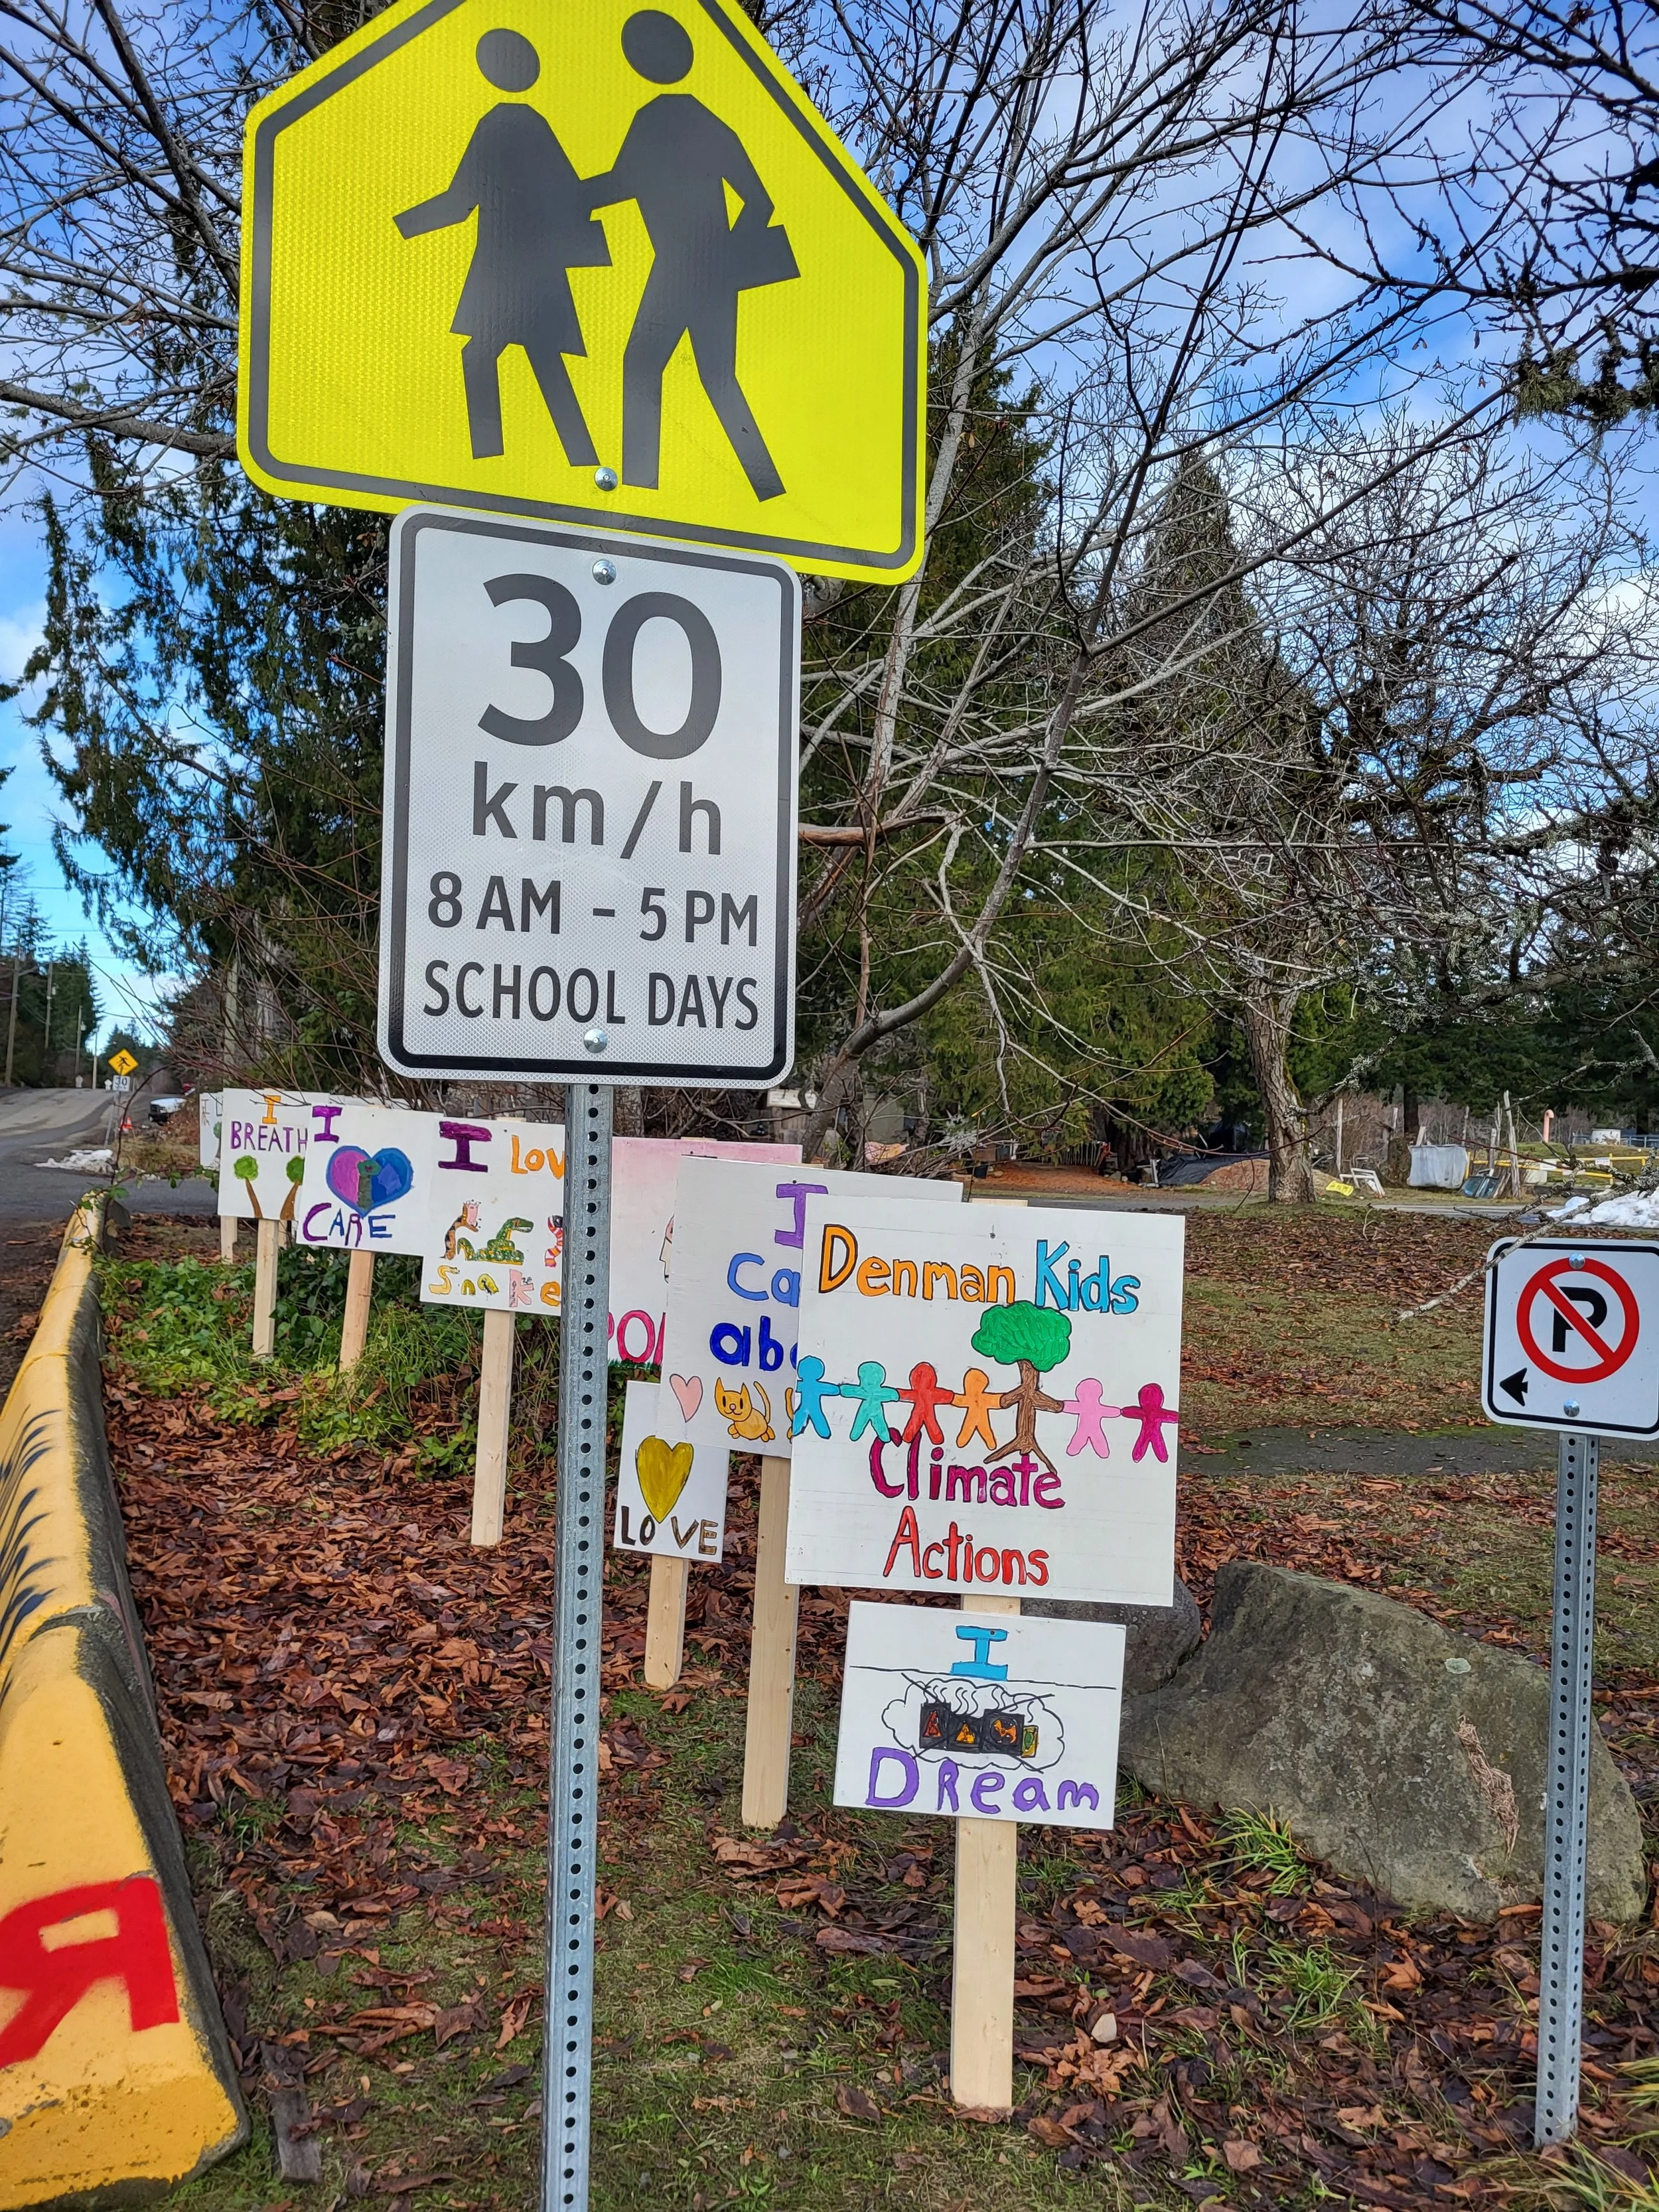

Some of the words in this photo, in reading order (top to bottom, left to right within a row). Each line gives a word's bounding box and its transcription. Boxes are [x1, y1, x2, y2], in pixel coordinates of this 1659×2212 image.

[478, 573, 722, 760] 30
[472, 761, 721, 859] km/h
[423, 960, 626, 1024] SCHOOL
[648, 972, 758, 1030] DAYS
[263, 1095, 281, 1124] I
[312, 1105, 342, 1143] I
[438, 1121, 492, 1173] I
[303, 1203, 396, 1247] CARE
[774, 1183, 828, 1249] I
[818, 1224, 1015, 1304] Denman
[1035, 1238, 1142, 1315] Kids
[869, 1428, 1066, 1509] Climate
[621, 1505, 719, 1555] LOVE
[883, 1505, 1050, 1585] Actions
[950, 1625, 1009, 1682] I
